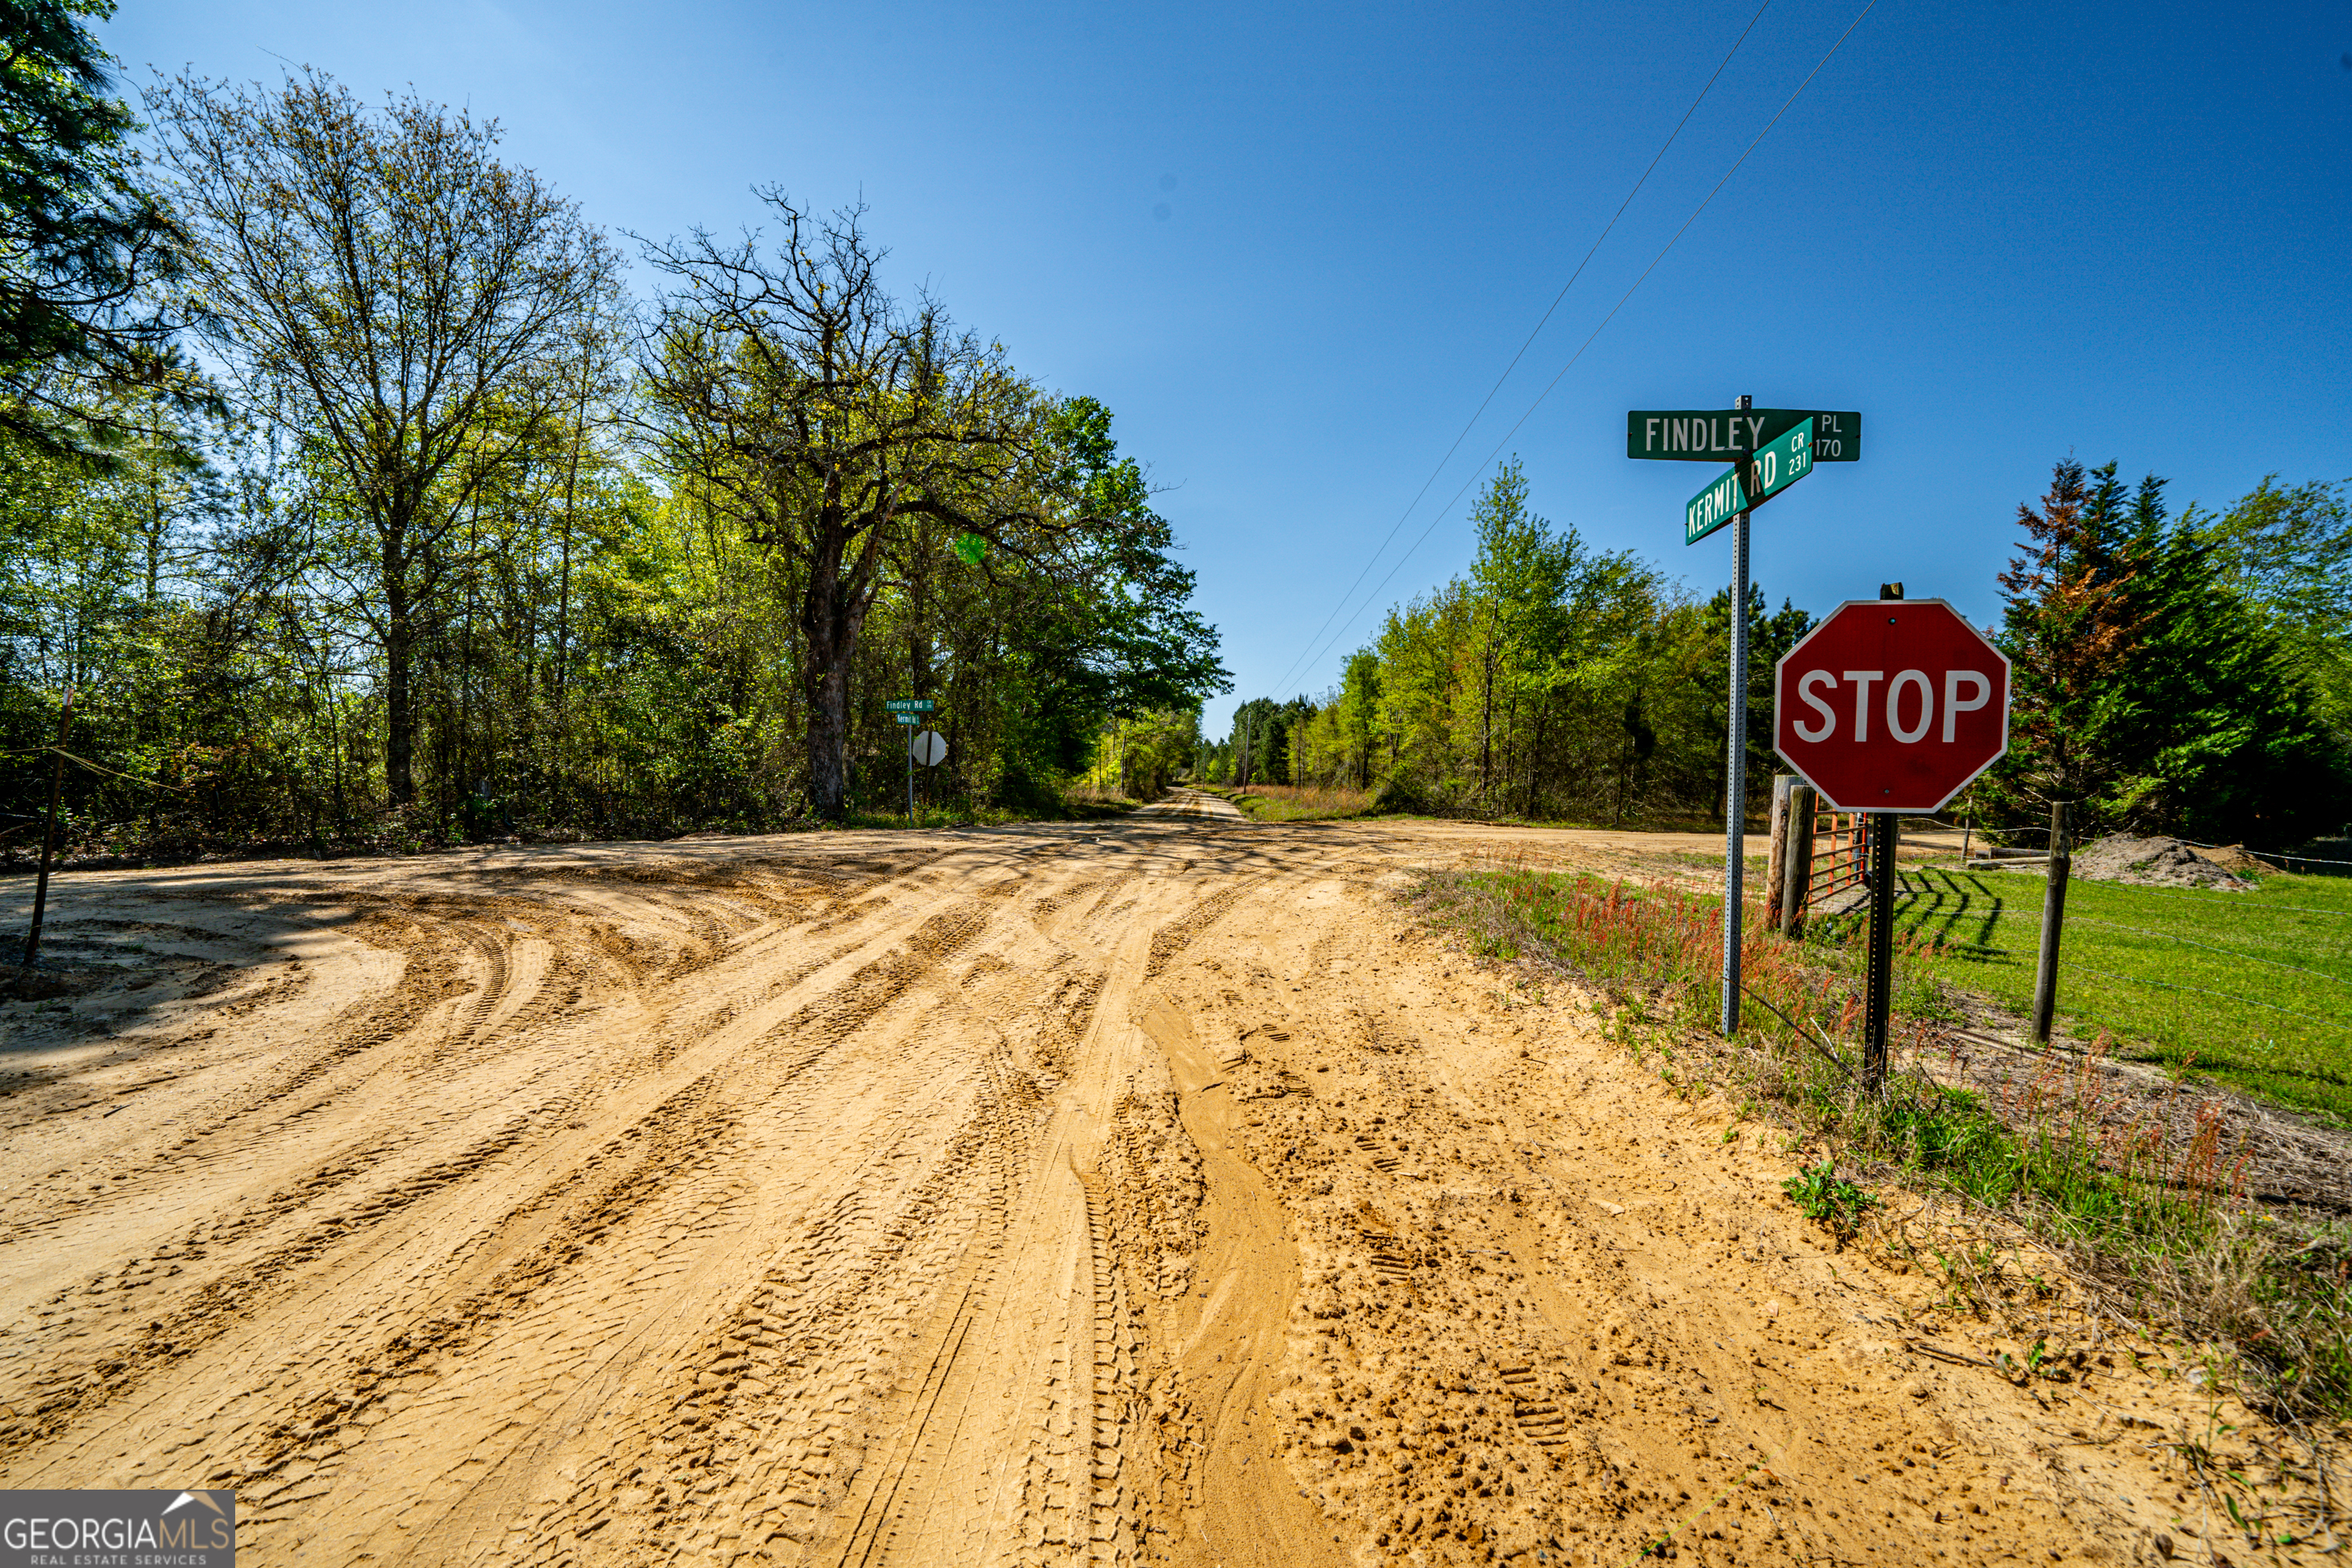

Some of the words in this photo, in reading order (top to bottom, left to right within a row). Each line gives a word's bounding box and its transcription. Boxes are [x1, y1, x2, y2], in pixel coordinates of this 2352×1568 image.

[1646, 416, 1765, 452] FINDLEY
[1821, 414, 1842, 432] PL
[1791, 432, 1804, 452] CR
[1815, 439, 1842, 457] 170
[1788, 452, 1806, 476] 231
[1688, 473, 1740, 538] KERMIT
[1750, 451, 1777, 497] RD
[886, 701, 911, 710] Findley
[1793, 670, 1991, 743] STOP
